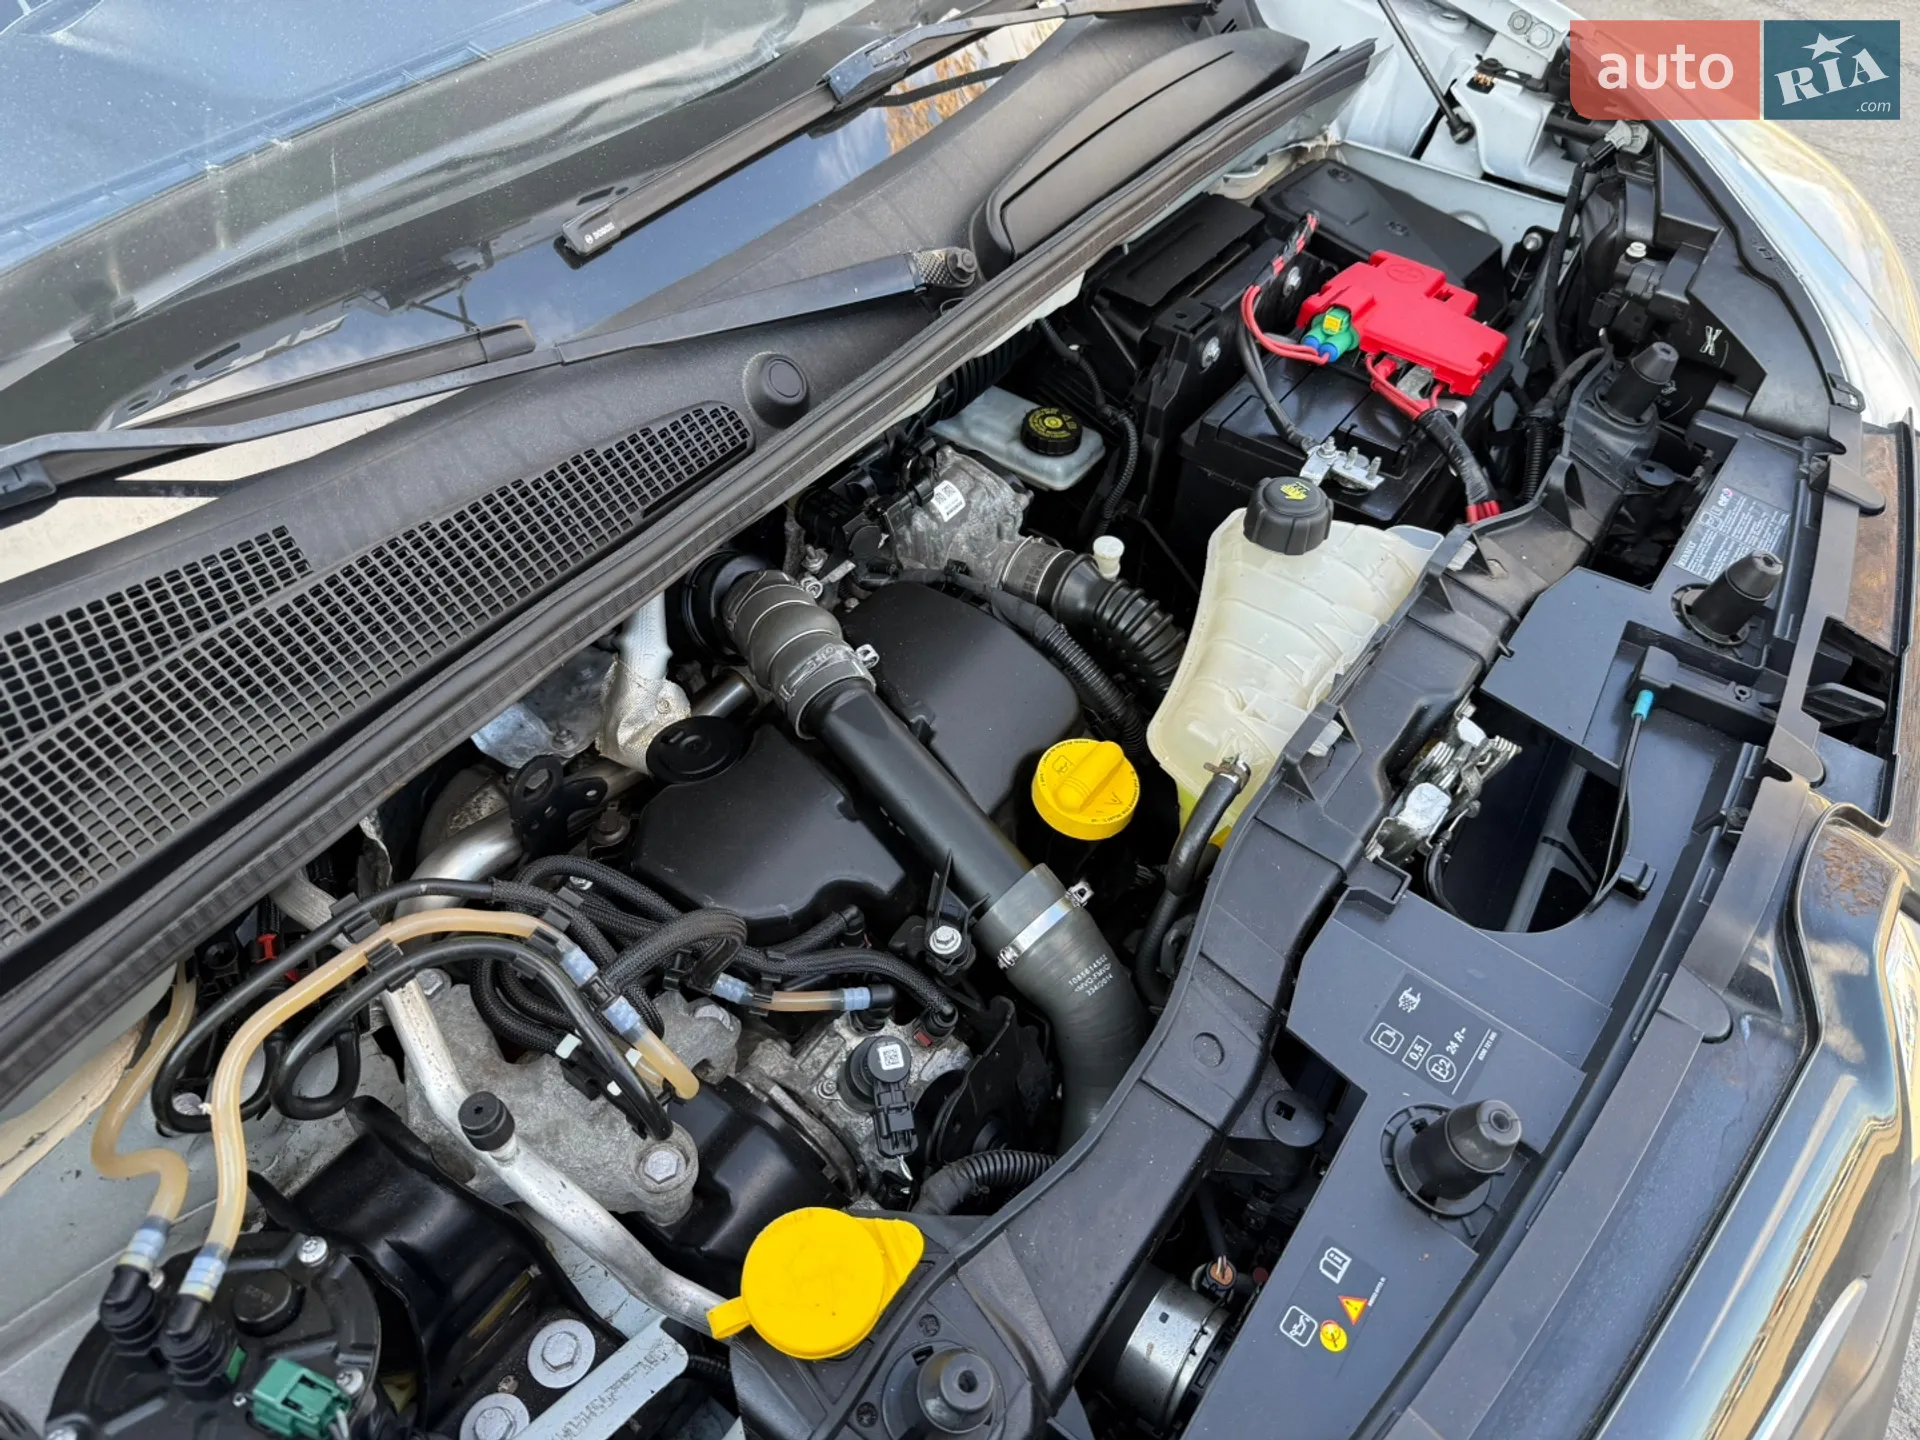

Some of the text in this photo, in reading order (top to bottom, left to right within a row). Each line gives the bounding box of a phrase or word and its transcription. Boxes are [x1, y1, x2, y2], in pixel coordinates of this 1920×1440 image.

[1408, 1043, 1424, 1061] 0,5
[1431, 1059, 1451, 1080] E2
[1446, 1040, 1460, 1055] 24
